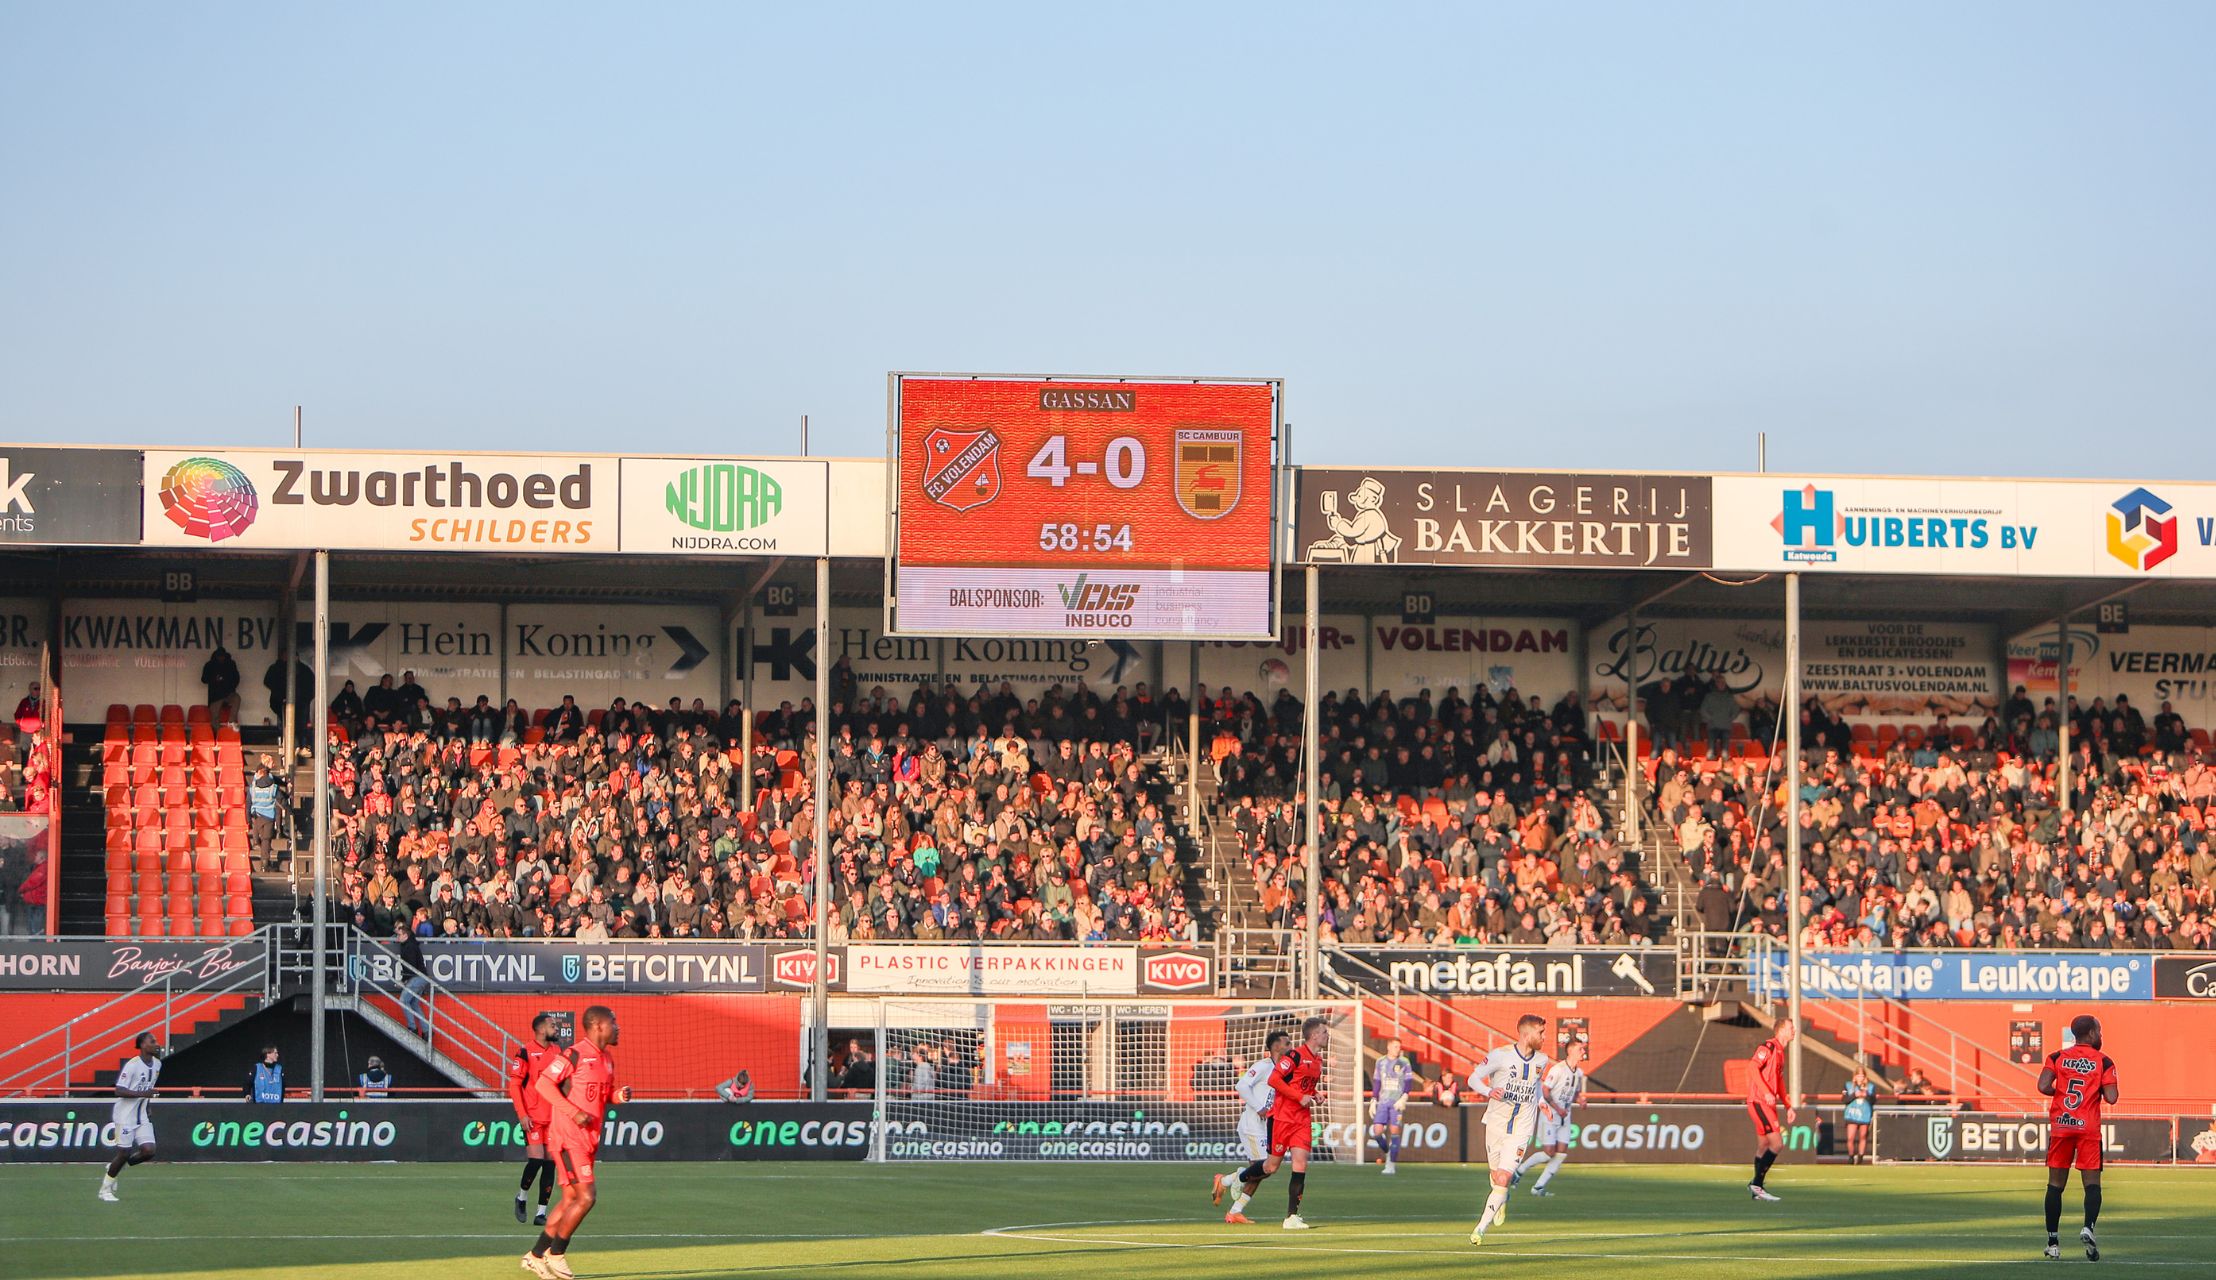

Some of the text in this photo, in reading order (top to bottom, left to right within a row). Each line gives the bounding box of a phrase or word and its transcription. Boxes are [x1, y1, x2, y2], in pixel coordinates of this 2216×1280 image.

[1043, 391, 1131, 408] GASSAN
[1178, 431, 1240, 441] SC CAMBUUR
[927, 433, 997, 498] FC VOLENDAM
[1027, 434, 1147, 489] 4-0
[272, 460, 591, 509] Zwarthoed
[1416, 483, 1686, 519] SLAGERIJ
[409, 518, 592, 544] SCHILDERS
[1039, 523, 1132, 552] 58:54
[2001, 526, 2038, 550] BV
[2196, 517, 2216, 546] V
[672, 536, 777, 551] NIJDRA.COM
[1414, 518, 1691, 566] BAKKERTJE
[165, 572, 193, 591] BB
[767, 586, 794, 605] BC
[949, 588, 1045, 608] BALSPONSOR:
[1405, 596, 1431, 613] BD
[1065, 613, 1132, 628] INBUCO
[2100, 604, 2124, 622] BE
[64, 616, 275, 649] KWAKMAN BV
[1867, 624, 1924, 635] VOOR DE
[400, 622, 656, 667] Hein Koning
[839, 628, 930, 661] Hein
[1377, 626, 1568, 653] VOLENDAM
[1825, 635, 1966, 648] LEKKERSTE BROODJES
[1838, 647, 1953, 659] EN DELICATESSEN!
[945, 673, 961, 683] EN
[970, 673, 1084, 684] BELASTINGADVIES
[1806, 664, 1986, 678] ZEESTRAAT 3 VOLENDAM
[1801, 679, 1989, 693] WWW.BALTUSVOLENDAM.NL
[586, 953, 756, 983] BETCITY.NL
[860, 955, 1124, 971] PLASTIC VERPAKKINGEN
[1150, 962, 1203, 979] KIVO
[906, 974, 971, 986] Innovation
[1016, 975, 1078, 986] motivation
[1390, 953, 1582, 993] metafa.nl
[1050, 1006, 1065, 1014] WC
[1116, 1006, 1131, 1014] WC
[1138, 1006, 1168, 1014] HEREN
[560, 1028, 572, 1037] BC
[2064, 1079, 2084, 1110] 5
[191, 1110, 396, 1147] onecasino
[891, 1136, 1004, 1156] onecasino
[1039, 1136, 1151, 1156] onecasino
